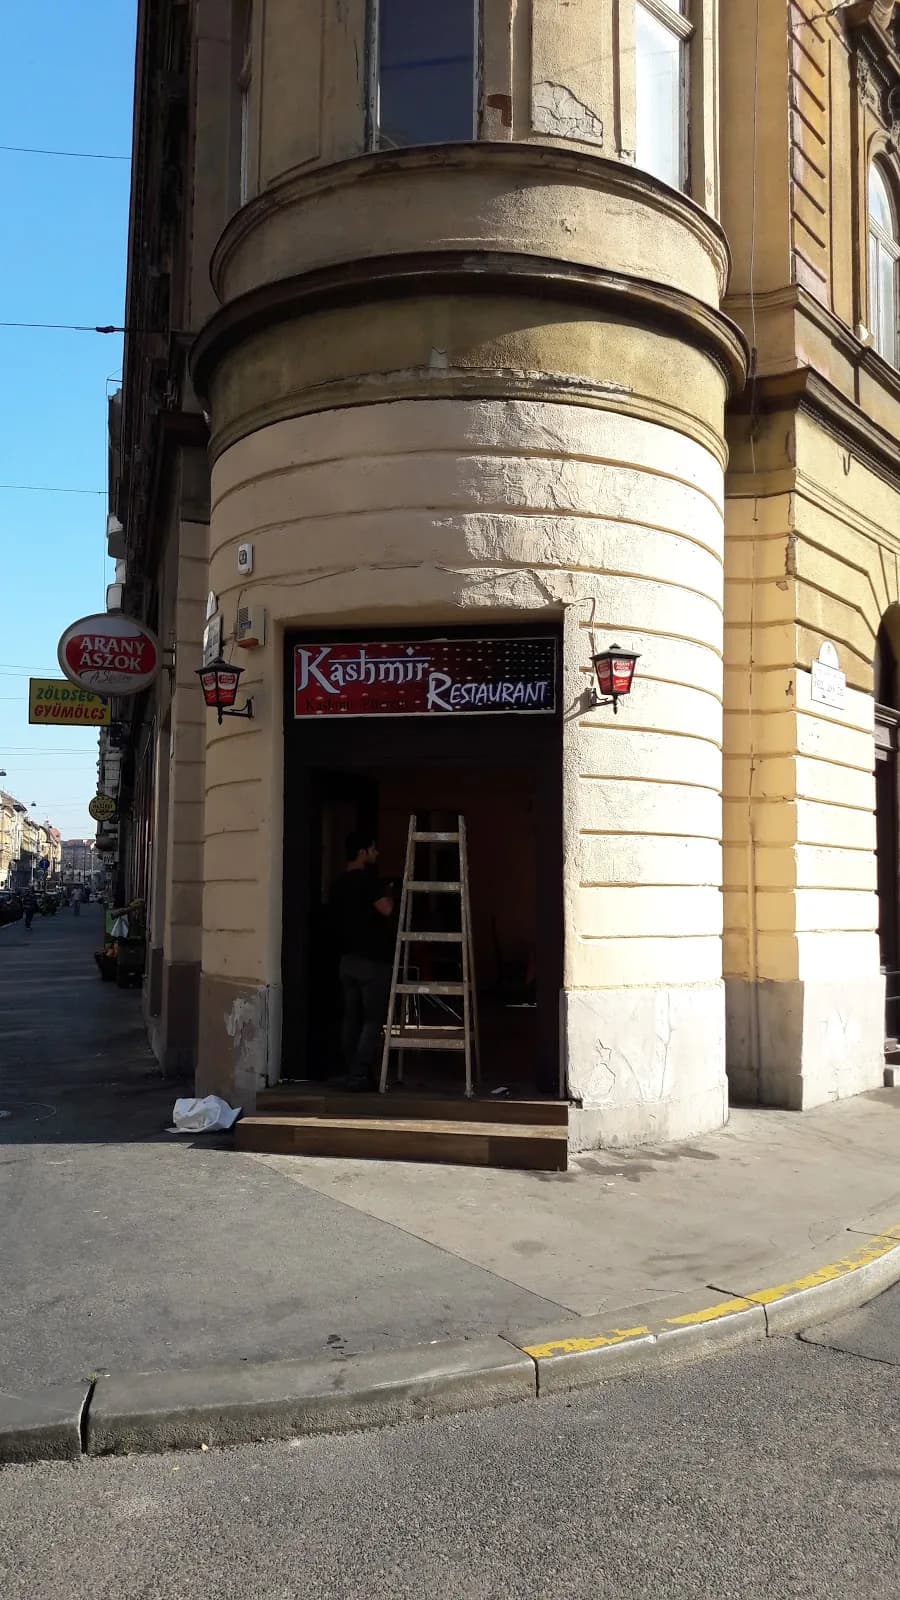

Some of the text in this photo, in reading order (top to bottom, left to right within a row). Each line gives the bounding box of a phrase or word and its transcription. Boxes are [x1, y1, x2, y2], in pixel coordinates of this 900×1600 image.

[80, 636, 146, 656] ARANY
[298, 647, 431, 694] Kashmir
[427, 672, 548, 711] RESTAURANT
[34, 702, 106, 719] GYÜMÖLCS
